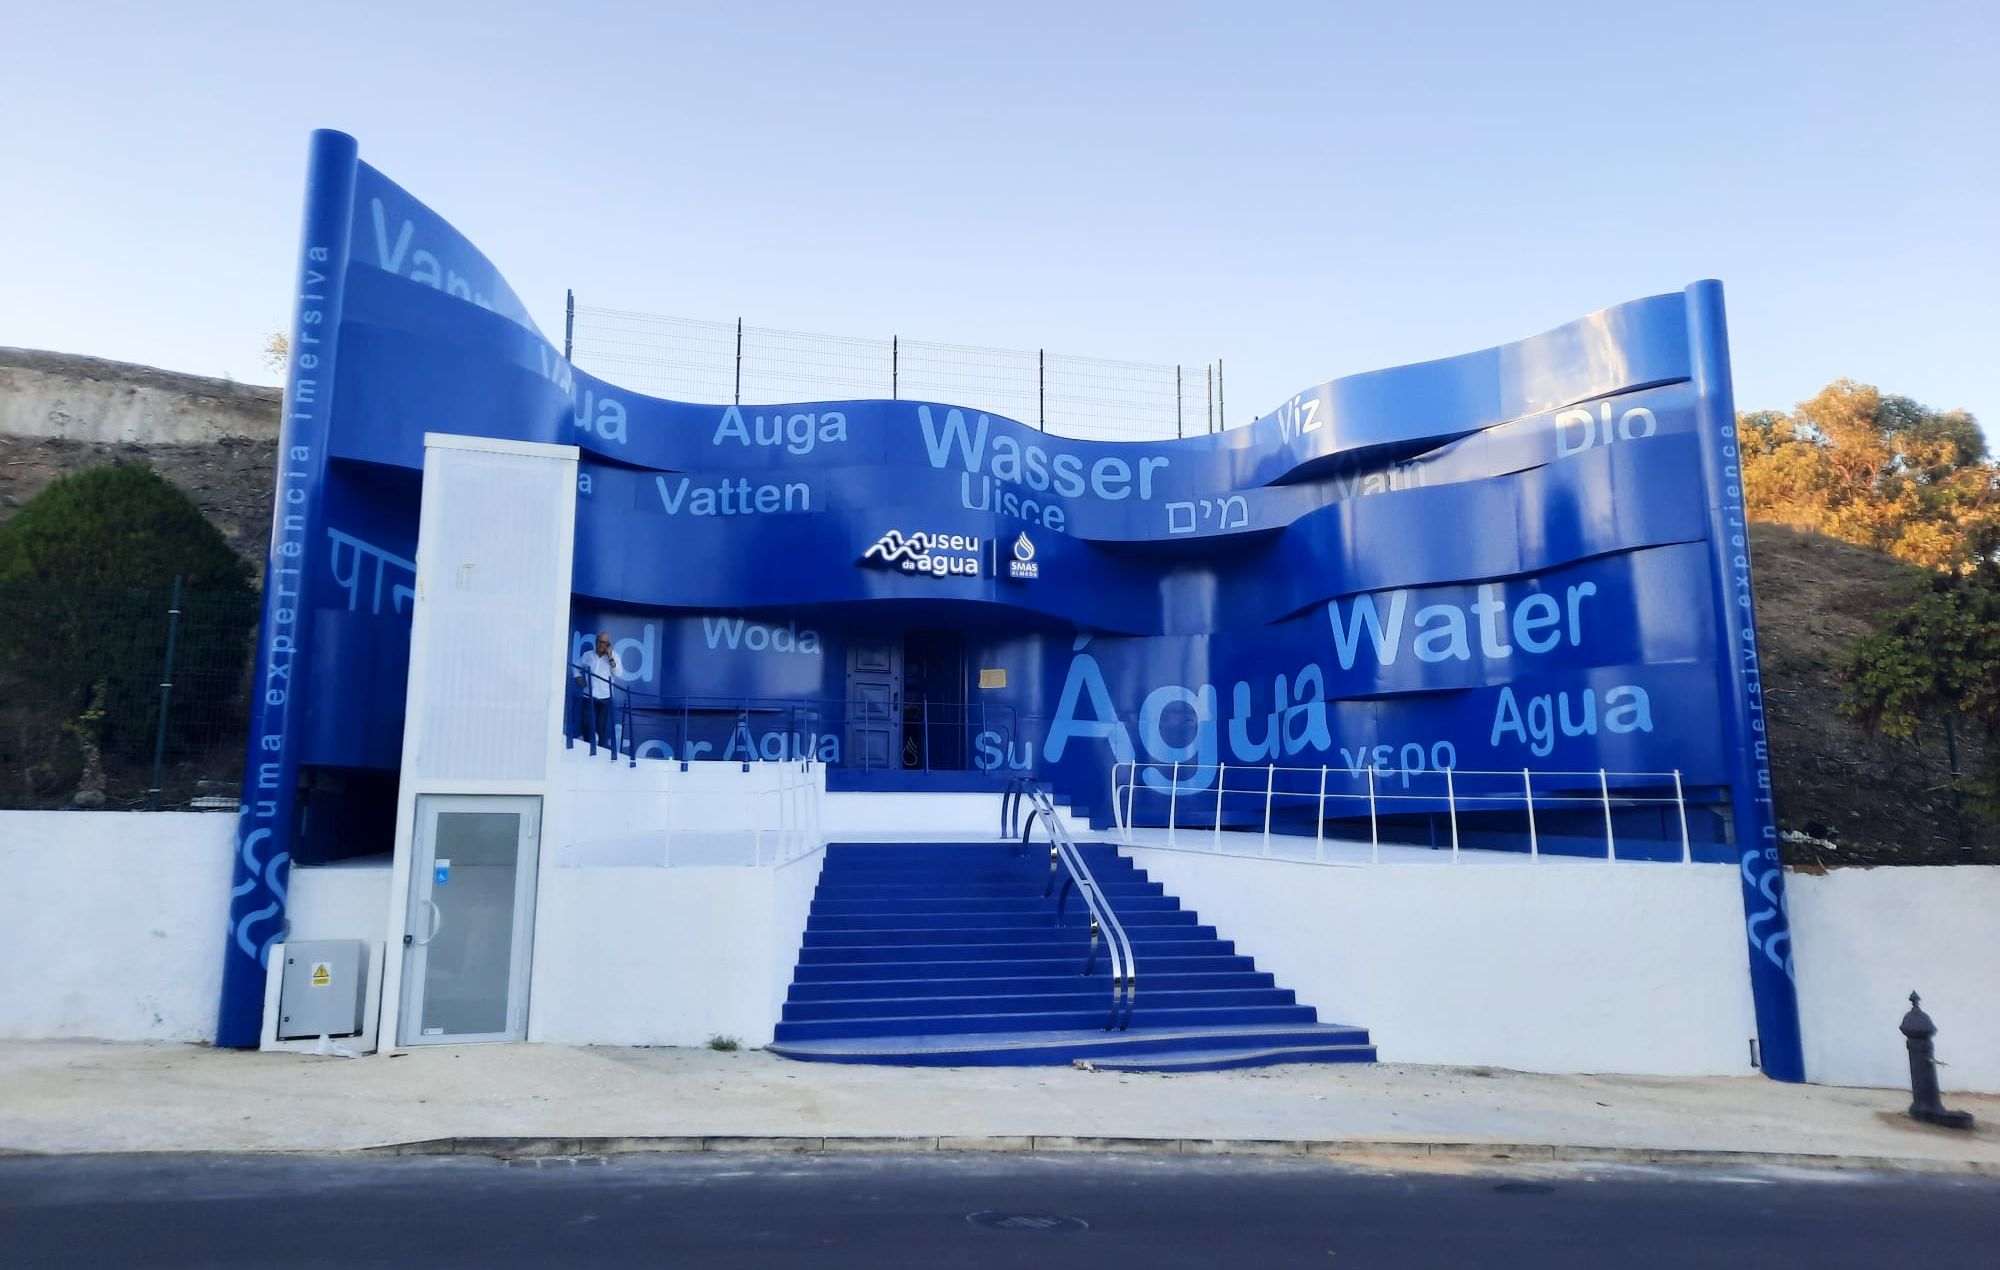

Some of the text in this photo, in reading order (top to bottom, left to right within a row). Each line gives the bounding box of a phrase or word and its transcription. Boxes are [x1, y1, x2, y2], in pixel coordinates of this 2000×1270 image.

[372, 198, 491, 310] Van
[712, 405, 848, 455] Auga
[917, 405, 1170, 501] Wasser
[1555, 401, 1657, 459] Dlo
[655, 475, 810, 516] Vatten
[962, 471, 1065, 533] Uisce
[1165, 495, 1249, 534] מים
[255, 246, 329, 817] uma experiência imersiva
[902, 559, 916, 571] da
[1011, 561, 1039, 572] SMAS
[702, 616, 822, 655] Woda
[1328, 581, 1597, 671] Water
[1721, 425, 1778, 861] an immersive experience
[1043, 634, 1332, 796] Água
[1491, 683, 1653, 757] Agua
